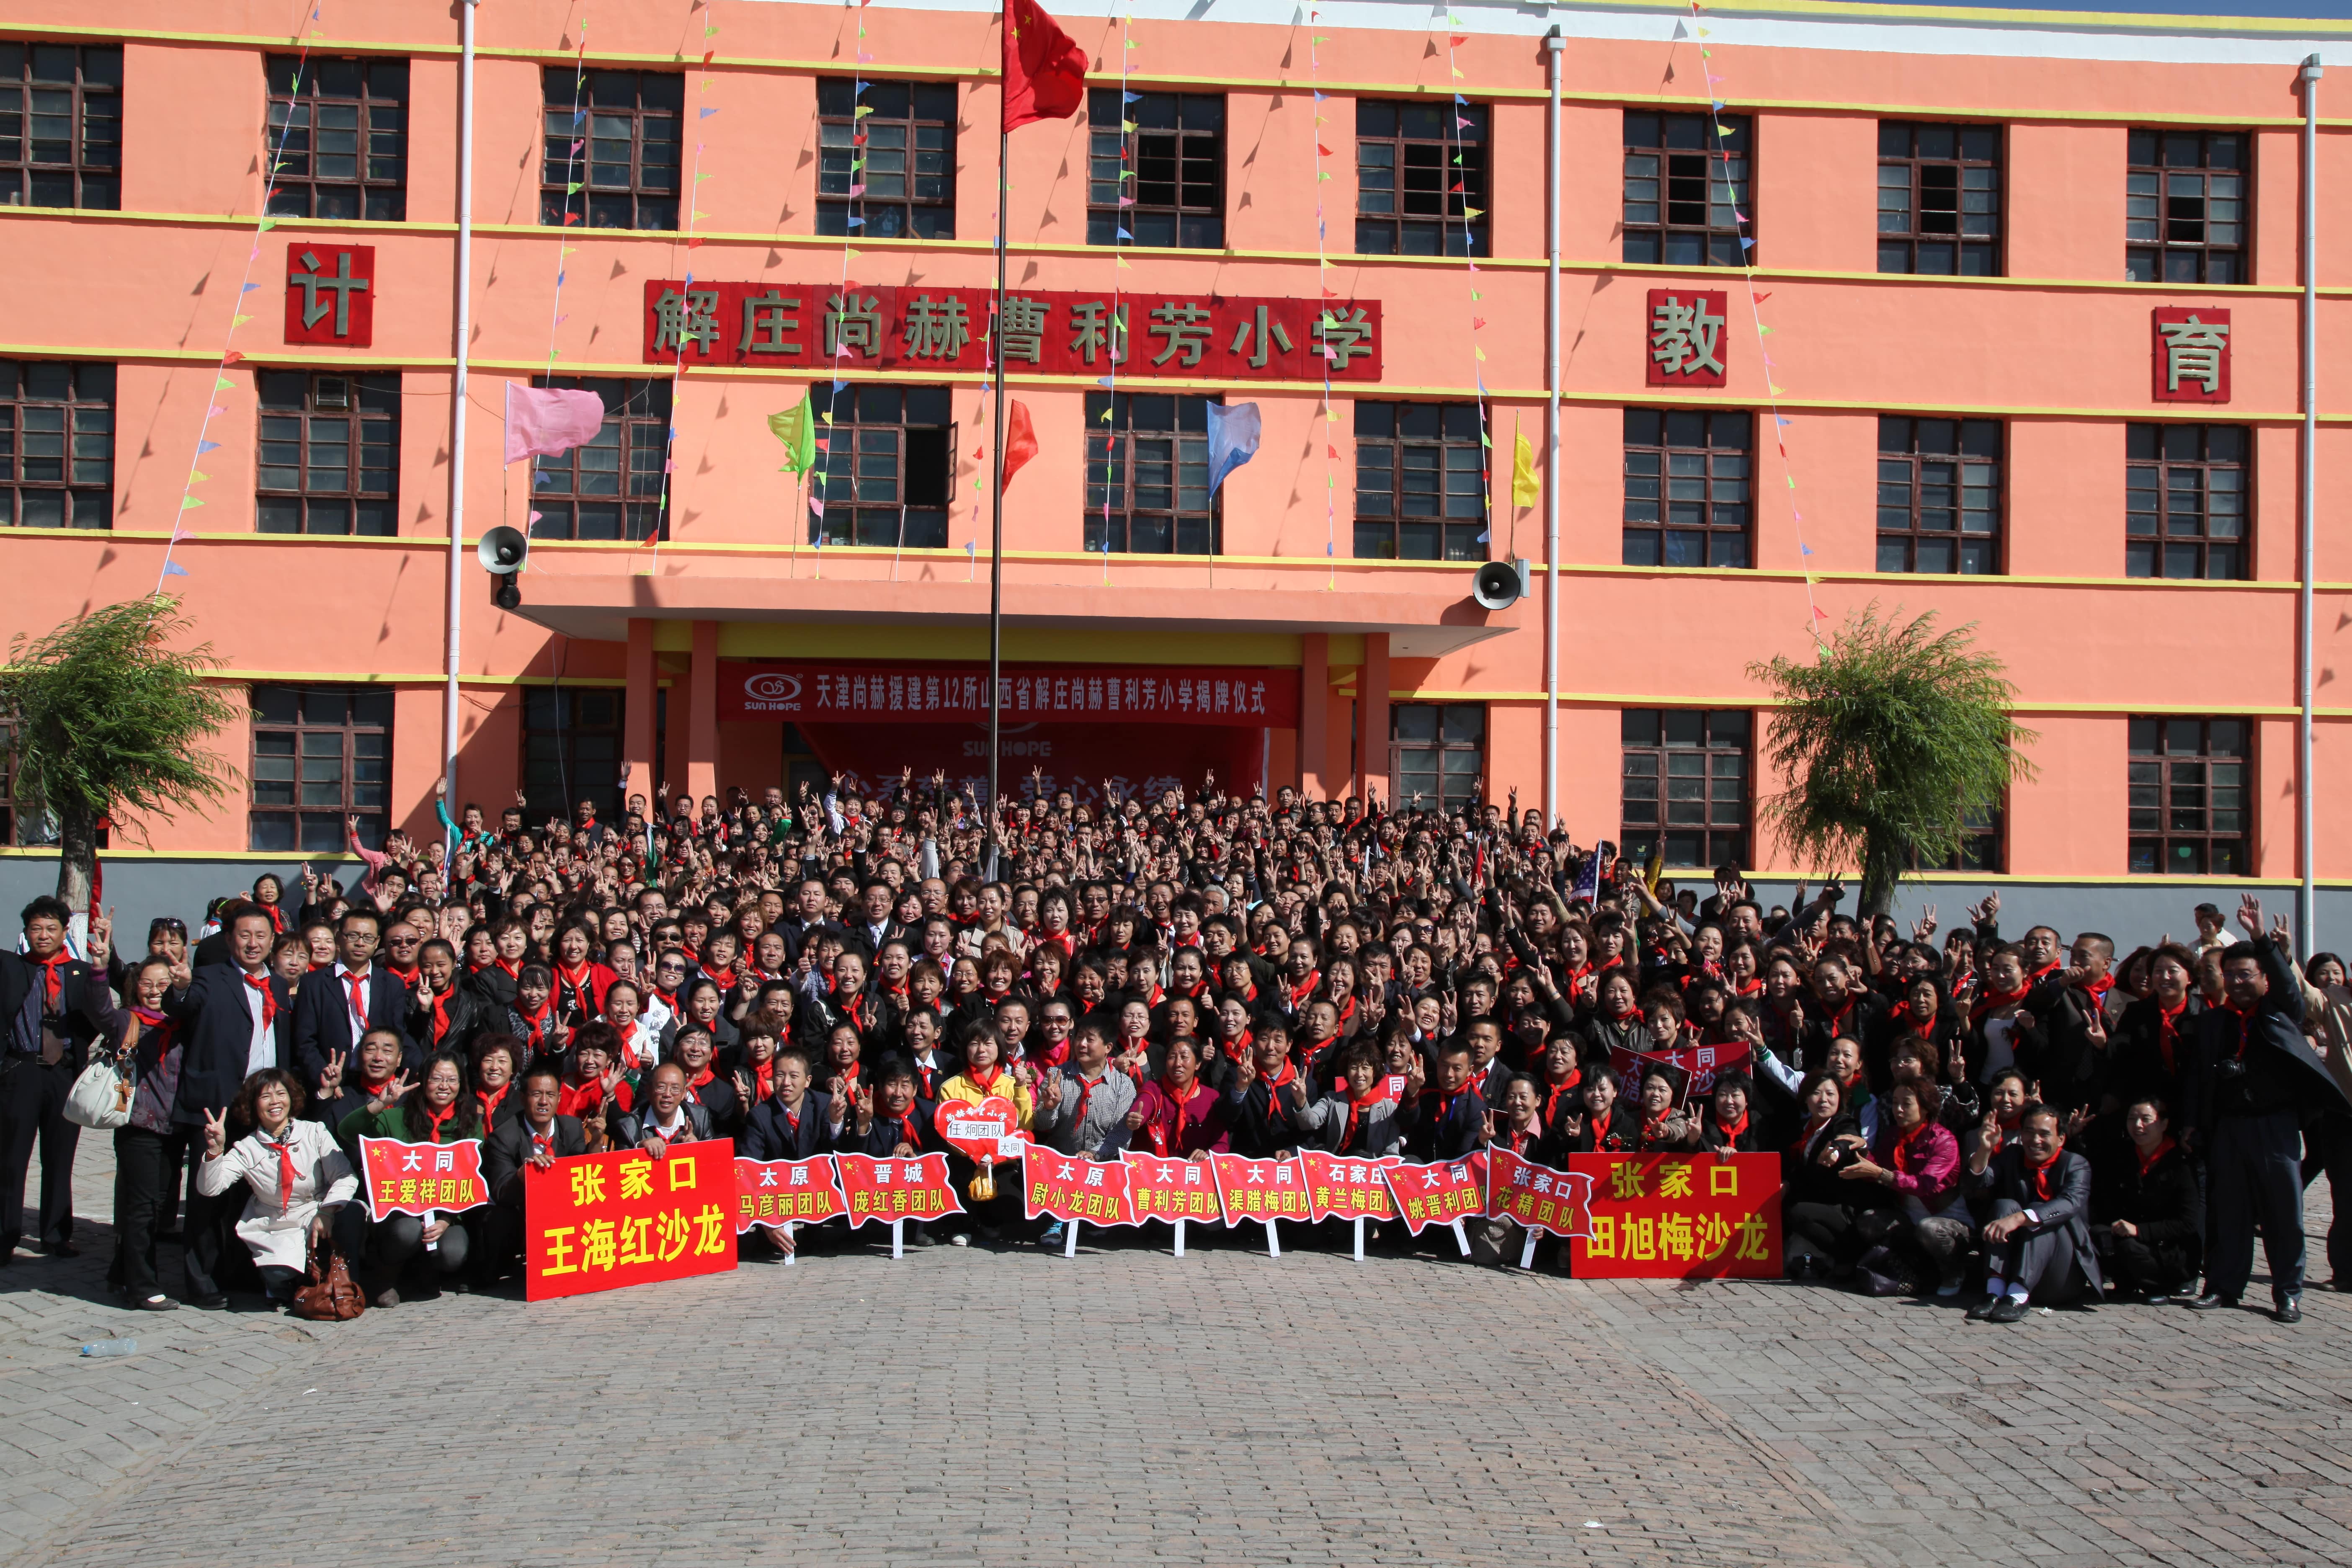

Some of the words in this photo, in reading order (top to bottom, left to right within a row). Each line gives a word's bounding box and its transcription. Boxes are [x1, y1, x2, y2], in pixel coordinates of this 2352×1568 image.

[291, 251, 369, 335] 计
[653, 288, 1372, 369] 解庄尚赫曹利芳小学
[1652, 297, 1725, 375] 教
[2161, 314, 2229, 392] 育
[769, 702, 801, 711] HOPE
[817, 674, 1265, 715] 天津尚赫援建第12所山西省解庄尚赫曹利芳小学揭牌仪式
[1001, 741, 1052, 757] HOPE
[1665, 1047, 1715, 1070] 大同
[946, 1107, 1007, 1122] 尚赫希望小学
[1001, 1143, 1019, 1153] 大同
[403, 1151, 454, 1171] 大同
[874, 1163, 923, 1183] 晋城
[571, 1156, 696, 1206] 张家口
[759, 1166, 808, 1187] 太原
[1056, 1162, 1105, 1186] 太原
[1156, 1163, 1200, 1185] 大同
[1247, 1165, 1291, 1184] 大同
[1329, 1164, 1386, 1184] 石家庄
[1421, 1164, 1469, 1189] 大同
[1514, 1166, 1571, 1200] 张家口
[1611, 1162, 1738, 1199] 张家口
[378, 1179, 475, 1204] 王爱祥团队
[740, 1191, 833, 1217] 马彦丽团队
[854, 1189, 945, 1213] 庞红香团队
[1031, 1182, 1120, 1220] 尉小龙团队
[1137, 1188, 1220, 1213] 曹利芳团队
[1496, 1186, 1573, 1231] 花精团队
[542, 1204, 726, 1276] 王海红沙龙
[1587, 1212, 1769, 1261] 田旭梅沙龙
